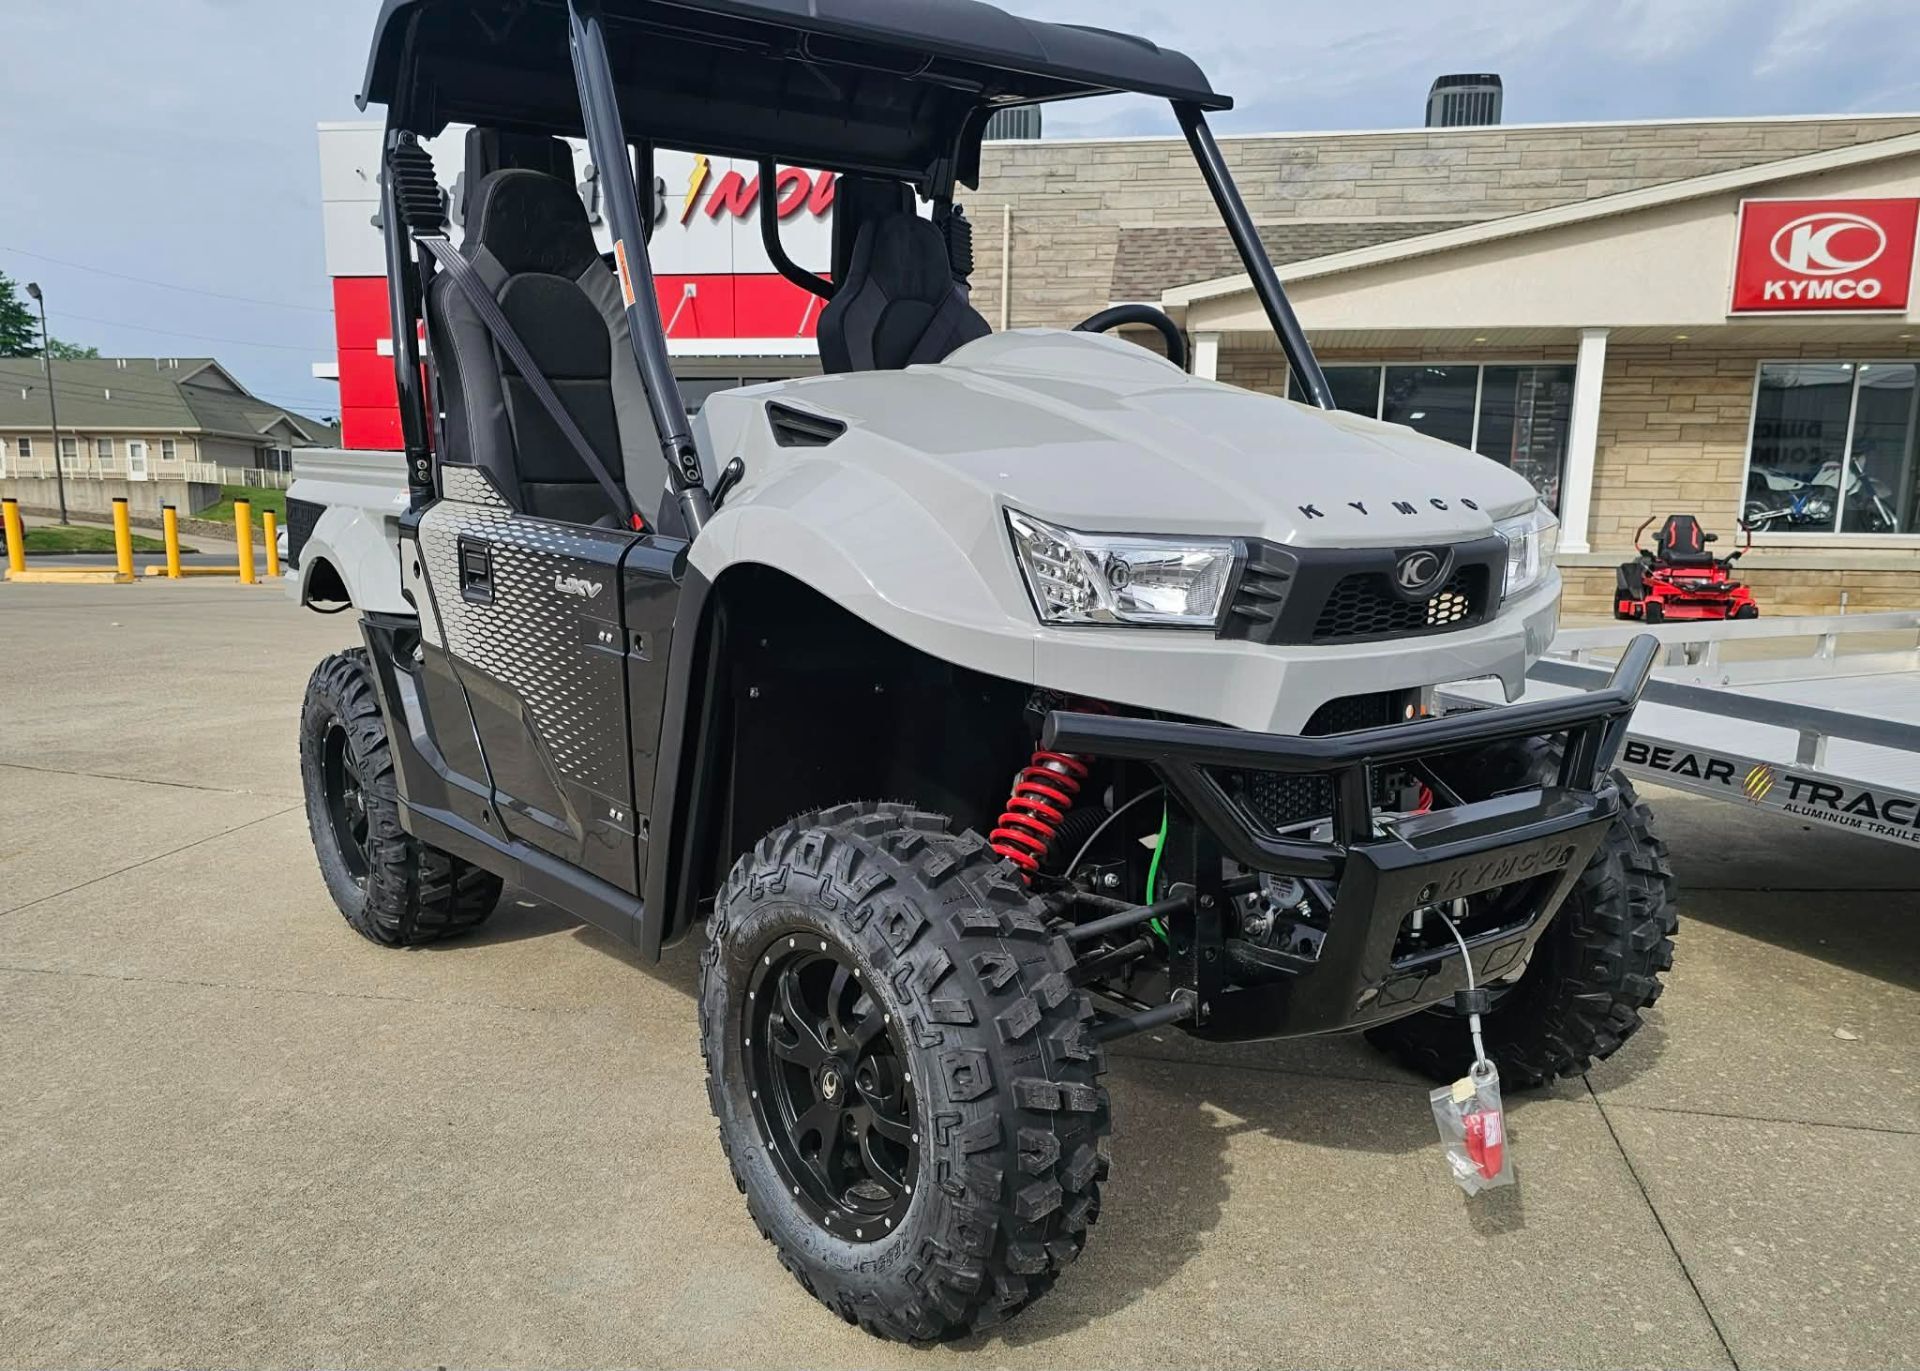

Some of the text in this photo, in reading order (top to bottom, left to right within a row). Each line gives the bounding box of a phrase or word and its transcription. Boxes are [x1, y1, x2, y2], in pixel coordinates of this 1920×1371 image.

[1764, 279, 1882, 300] KYMCO
[1298, 497, 1479, 520] KYMCO
[1622, 741, 1920, 829] BEAR TRAC
[1783, 803, 1863, 829] ALUMINUM
[1444, 846, 1560, 891] KYMCO
